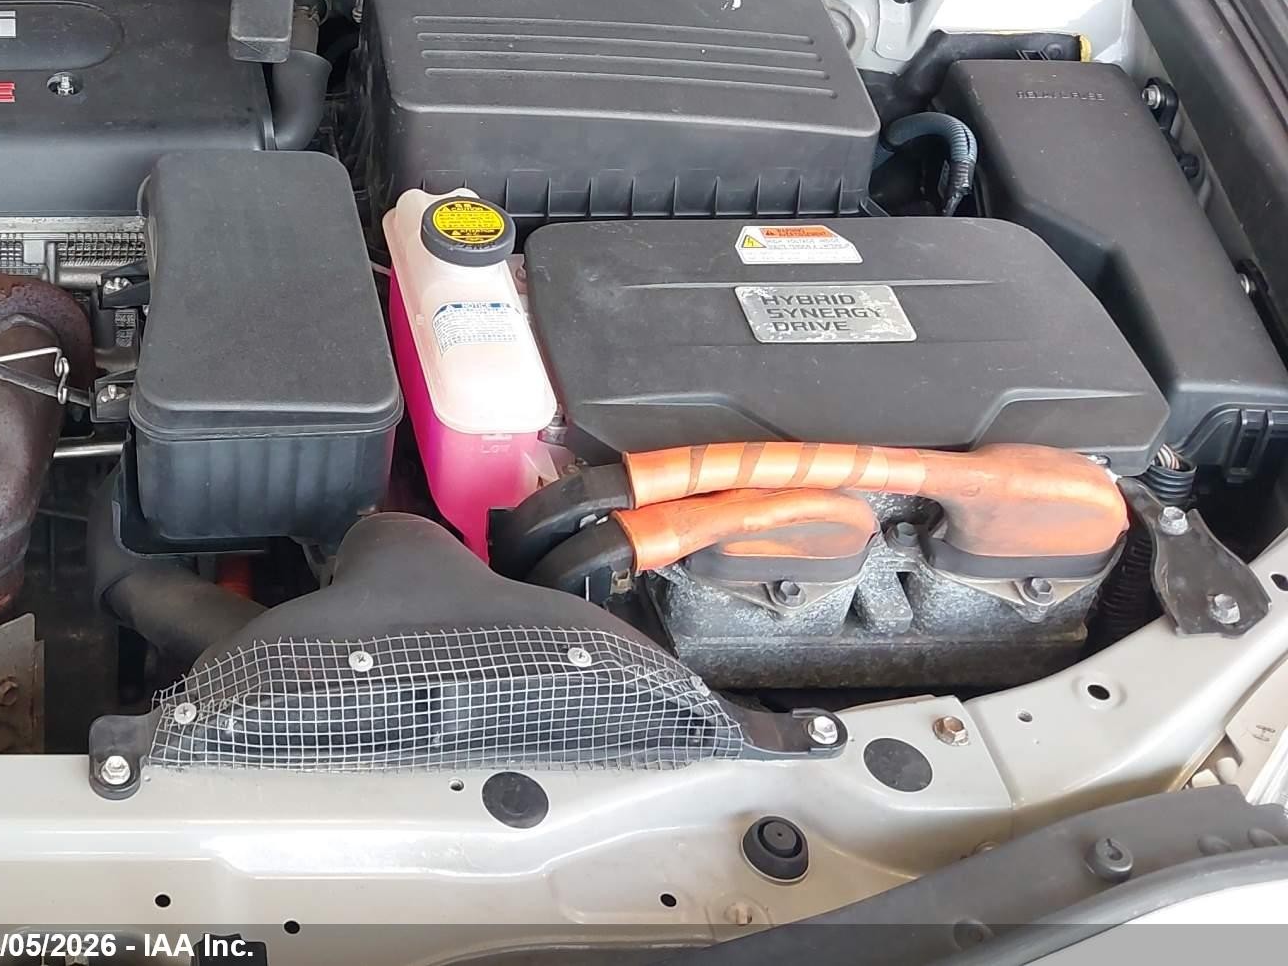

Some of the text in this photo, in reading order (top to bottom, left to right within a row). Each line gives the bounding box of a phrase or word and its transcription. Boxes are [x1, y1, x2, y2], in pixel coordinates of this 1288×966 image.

[763, 294, 856, 306] HYBRID
[766, 307, 882, 319] SYNERGY
[773, 321, 850, 332] DRIVE
